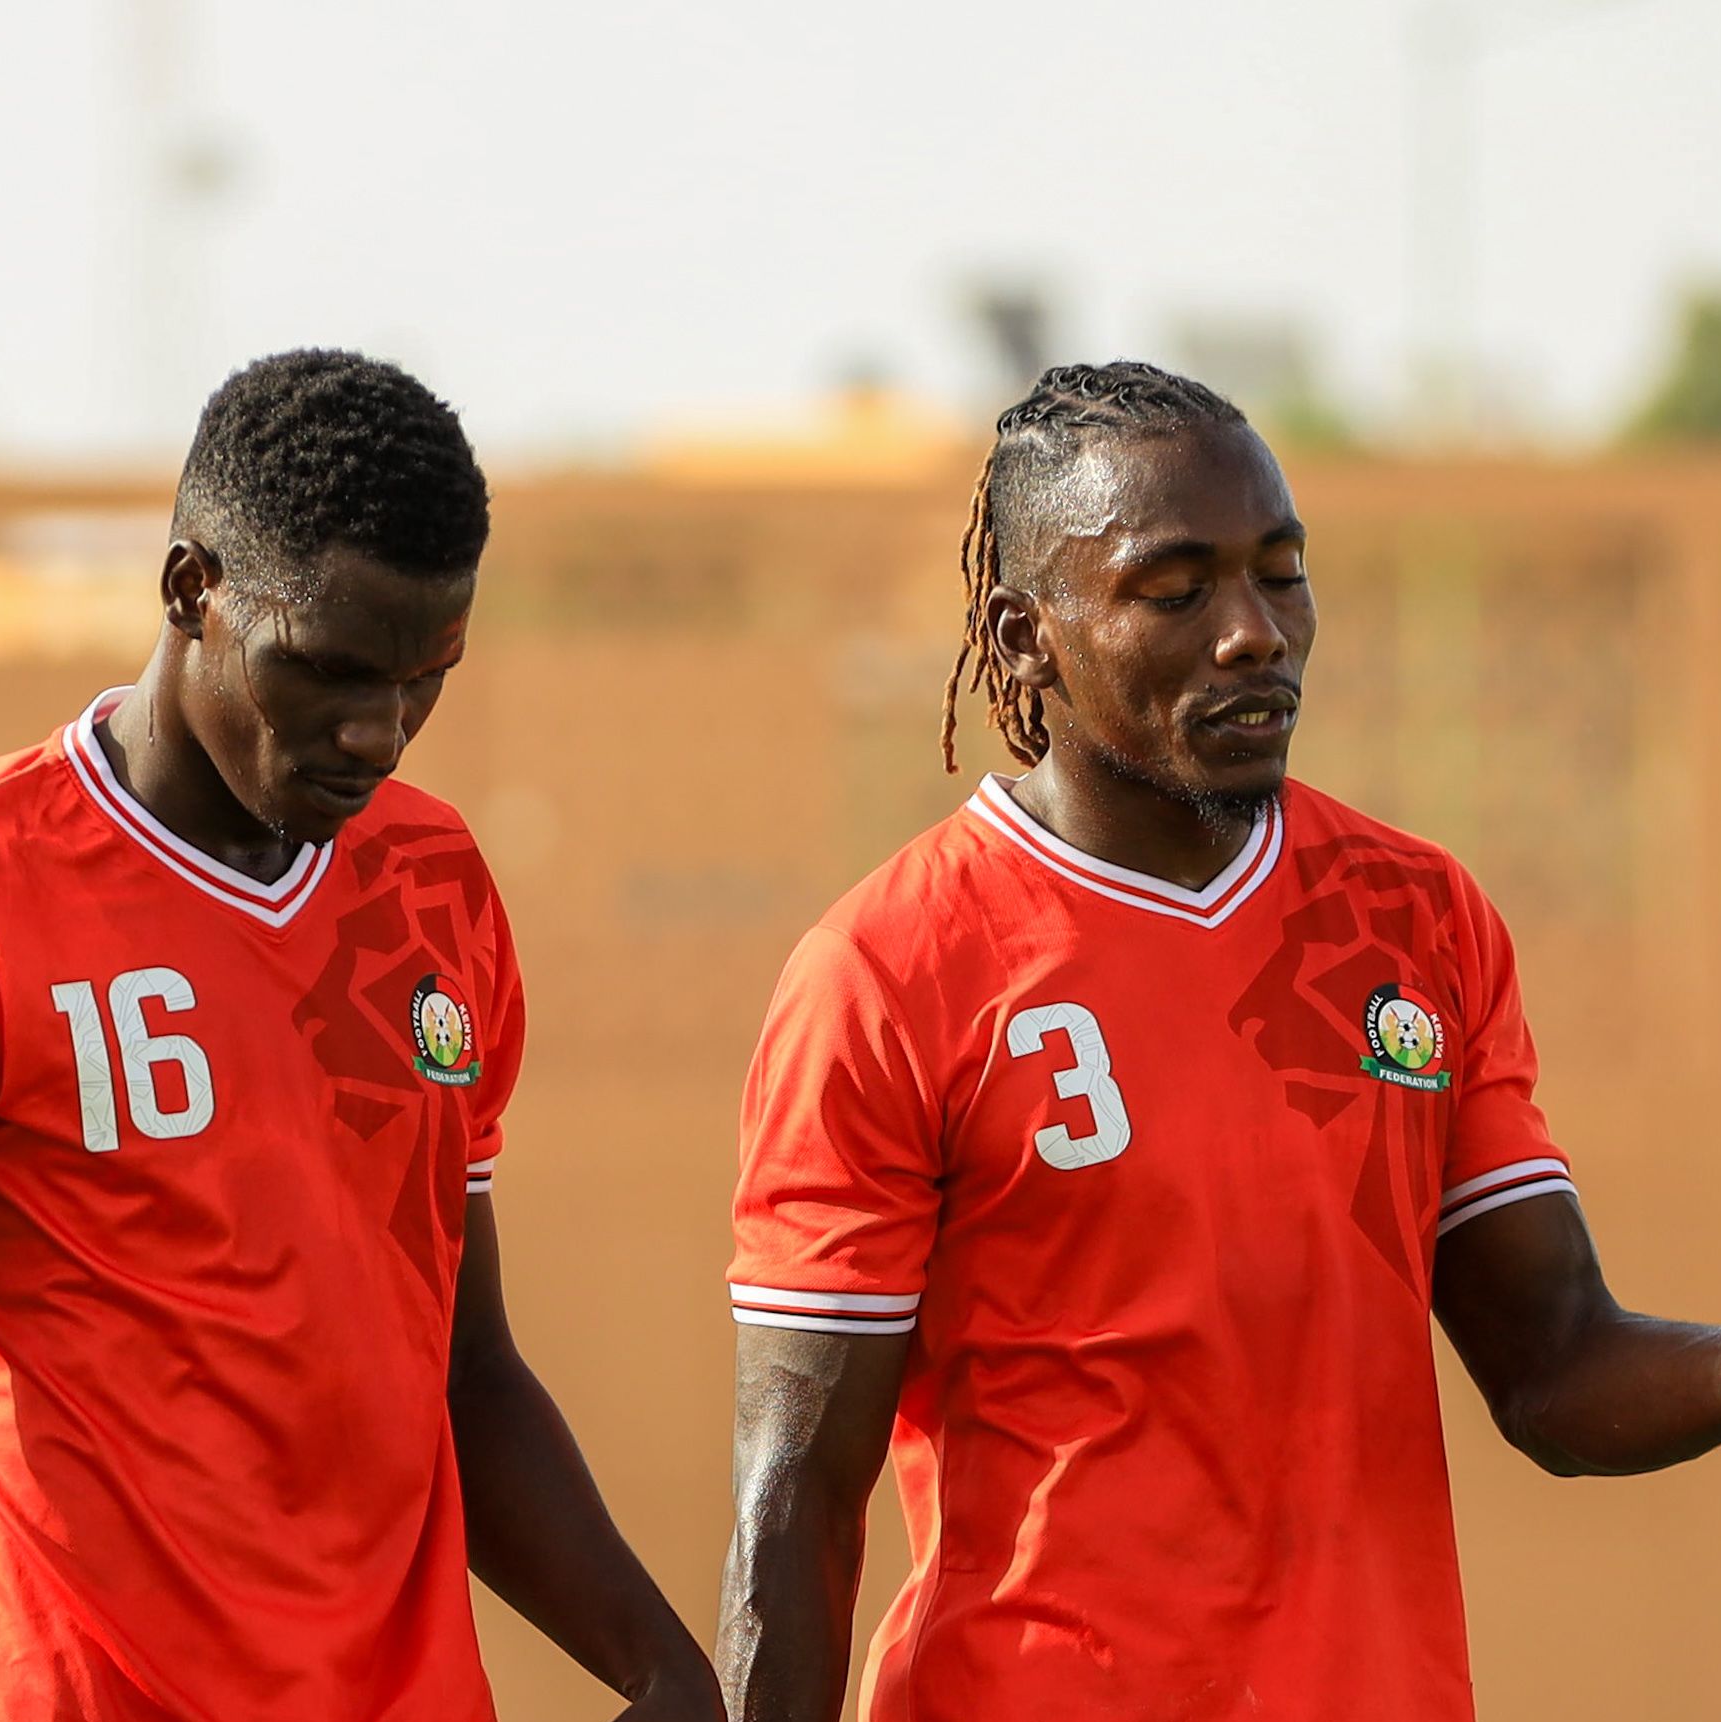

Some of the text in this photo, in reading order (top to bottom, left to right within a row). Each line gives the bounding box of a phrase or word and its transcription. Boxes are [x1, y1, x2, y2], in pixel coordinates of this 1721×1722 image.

[458, 1003, 472, 1051] KENYA
[1366, 994, 1386, 1058] FOOTBALL
[1430, 1013, 1446, 1059] KENYA
[50, 966, 216, 1153] 16
[426, 1068, 471, 1083] FEDERATION
[1379, 1069, 1439, 1089] FEDERATION
[1007, 1002, 1133, 1171] 3
